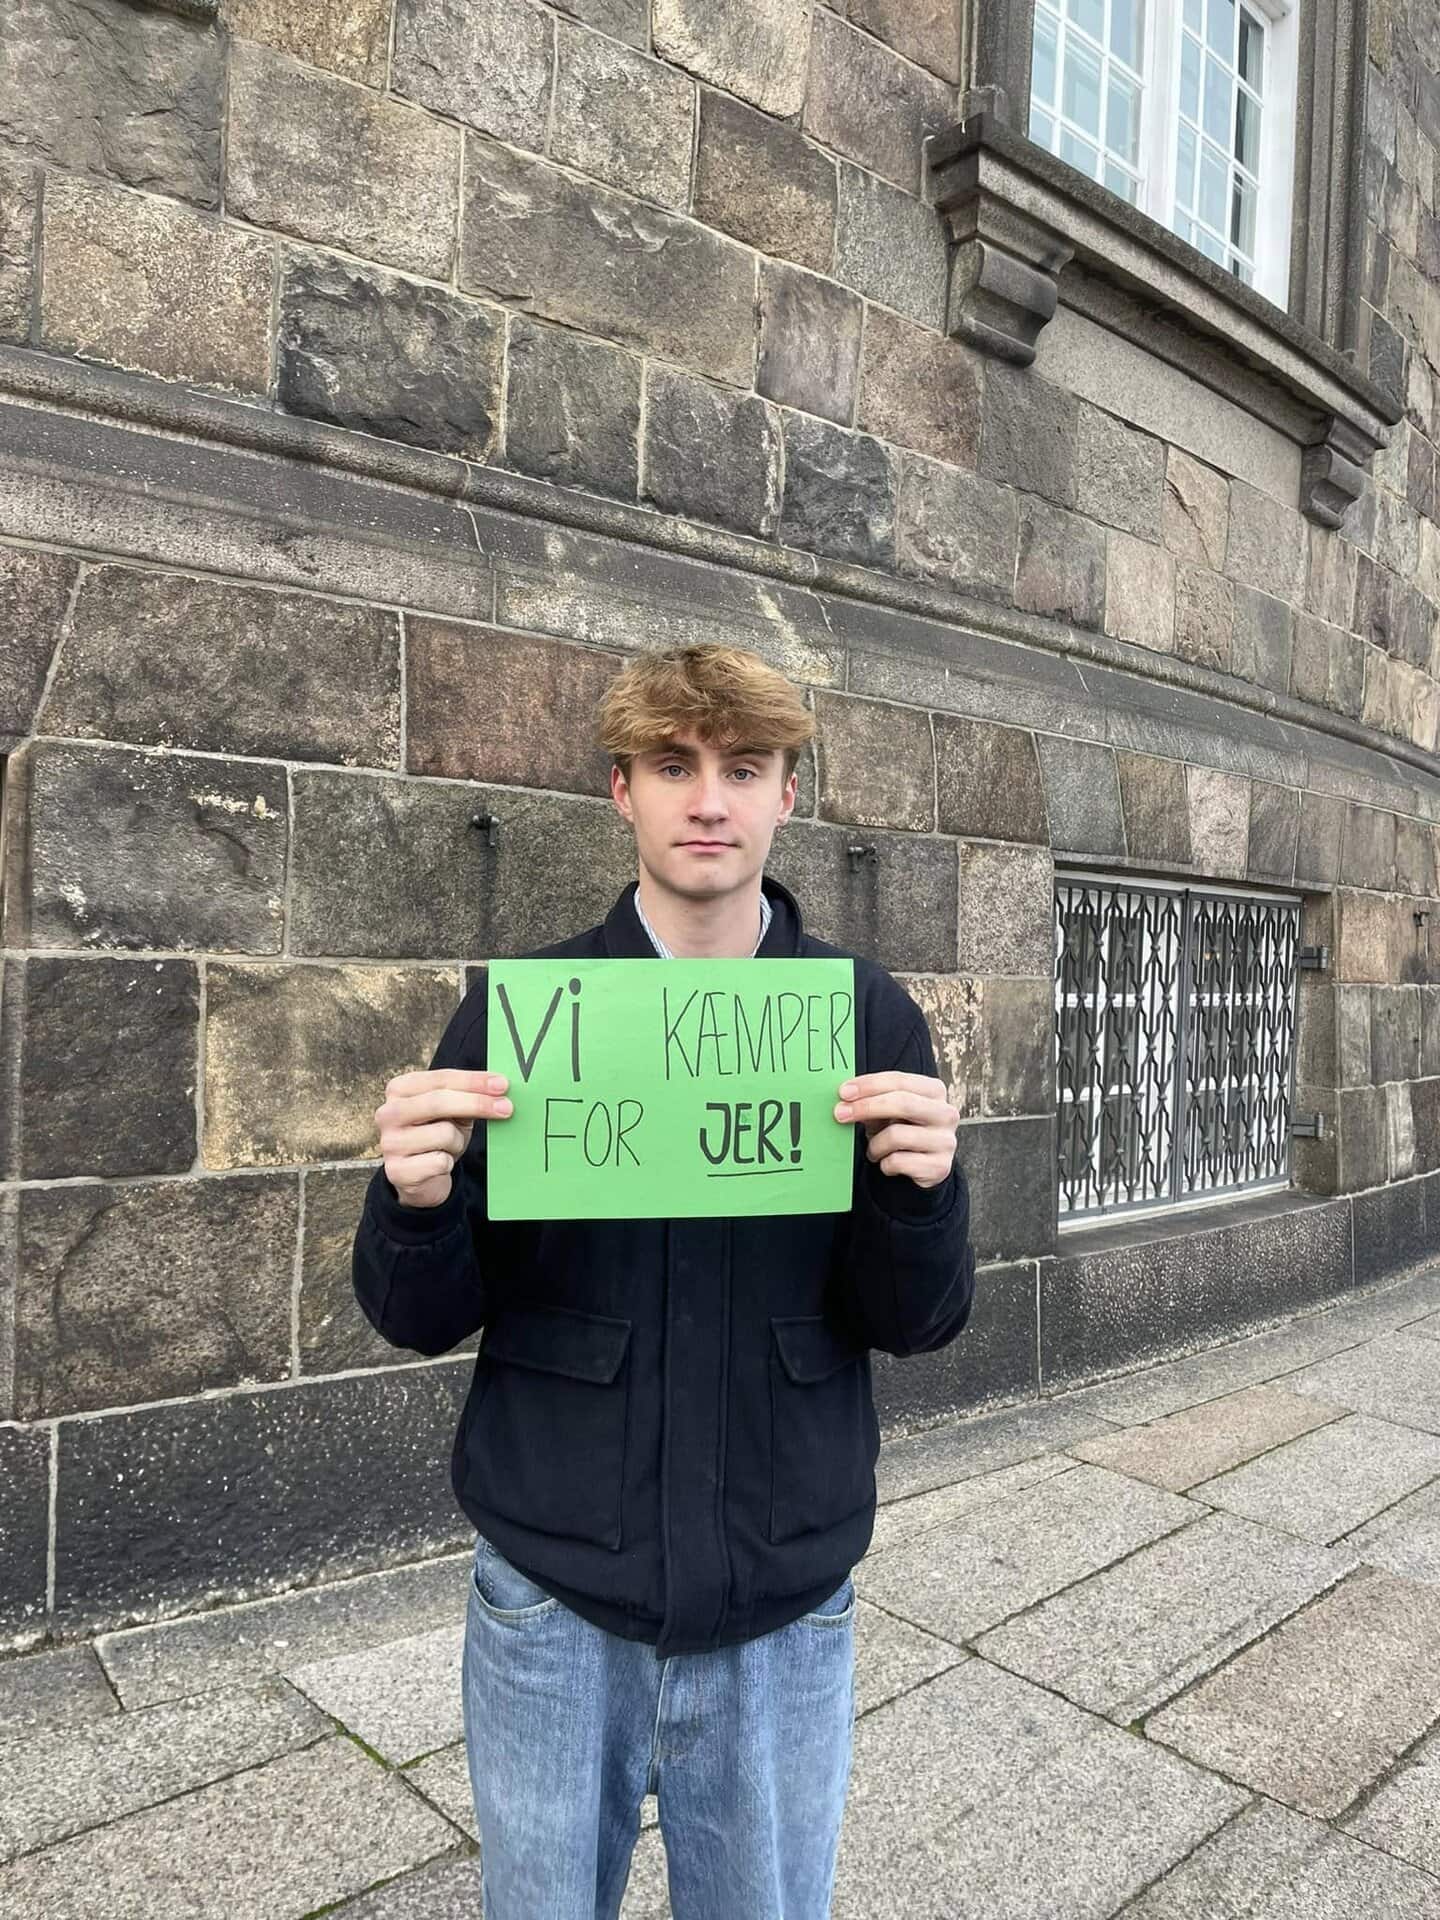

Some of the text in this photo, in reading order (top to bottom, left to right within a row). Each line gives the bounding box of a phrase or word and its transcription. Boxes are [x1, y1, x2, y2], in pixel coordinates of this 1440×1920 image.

[663, 987, 852, 1081] KÆMPER
[544, 1098, 802, 1173] FOR JER!
